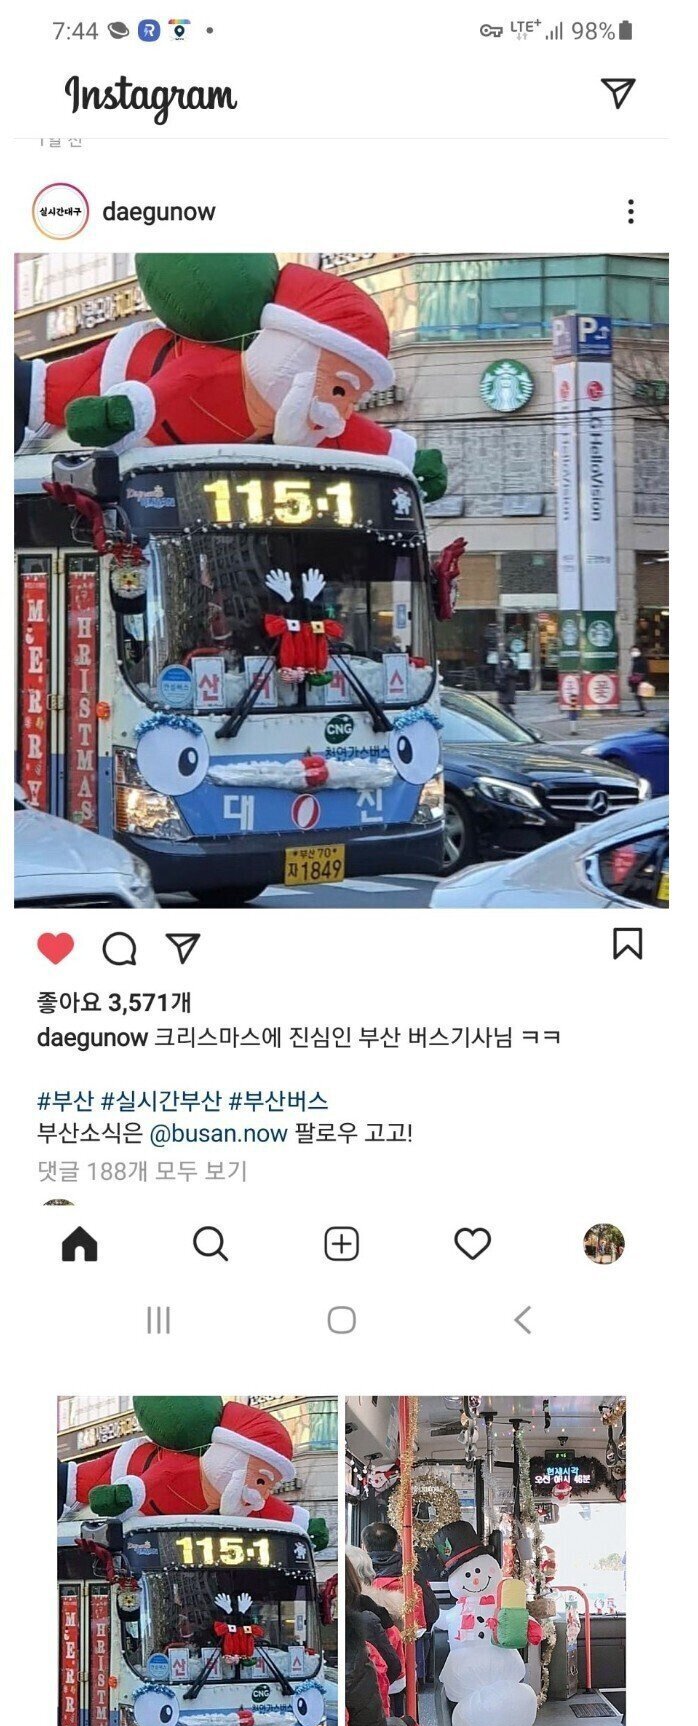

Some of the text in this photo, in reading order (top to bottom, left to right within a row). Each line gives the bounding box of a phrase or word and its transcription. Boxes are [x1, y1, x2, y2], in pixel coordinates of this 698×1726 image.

[53, 21, 98, 41] 7:44
[571, 21, 616, 41] 98%
[65, 75, 237, 125] Instagram
[39, 207, 82, 217] 실시간대구
[103, 201, 216, 226] daegunow
[578, 317, 598, 342] P
[27, 599, 44, 806] MERRY
[326, 723, 352, 736] CNG
[224, 795, 255, 831] 대
[356, 789, 383, 823] 진
[318, 847, 332, 859] 70
[301, 859, 342, 881] 1849
[37, 991, 191, 1015] 좋아요 3,571개
[37, 1026, 560, 1052] daegunow 크리스마스에 진심인 부산 버스기사님 ㅋㅋ
[37, 1090, 329, 1113] #부산 #실시간부산 #부산버스
[37, 1121, 413, 1148] 부산소식은 @busan.now 팔로우 고고!
[38, 1160, 246, 1183] 댓글 188개 모두 보기
[546, 1466, 580, 1476] 현재시각
[252, 1689, 270, 1699] CNG
